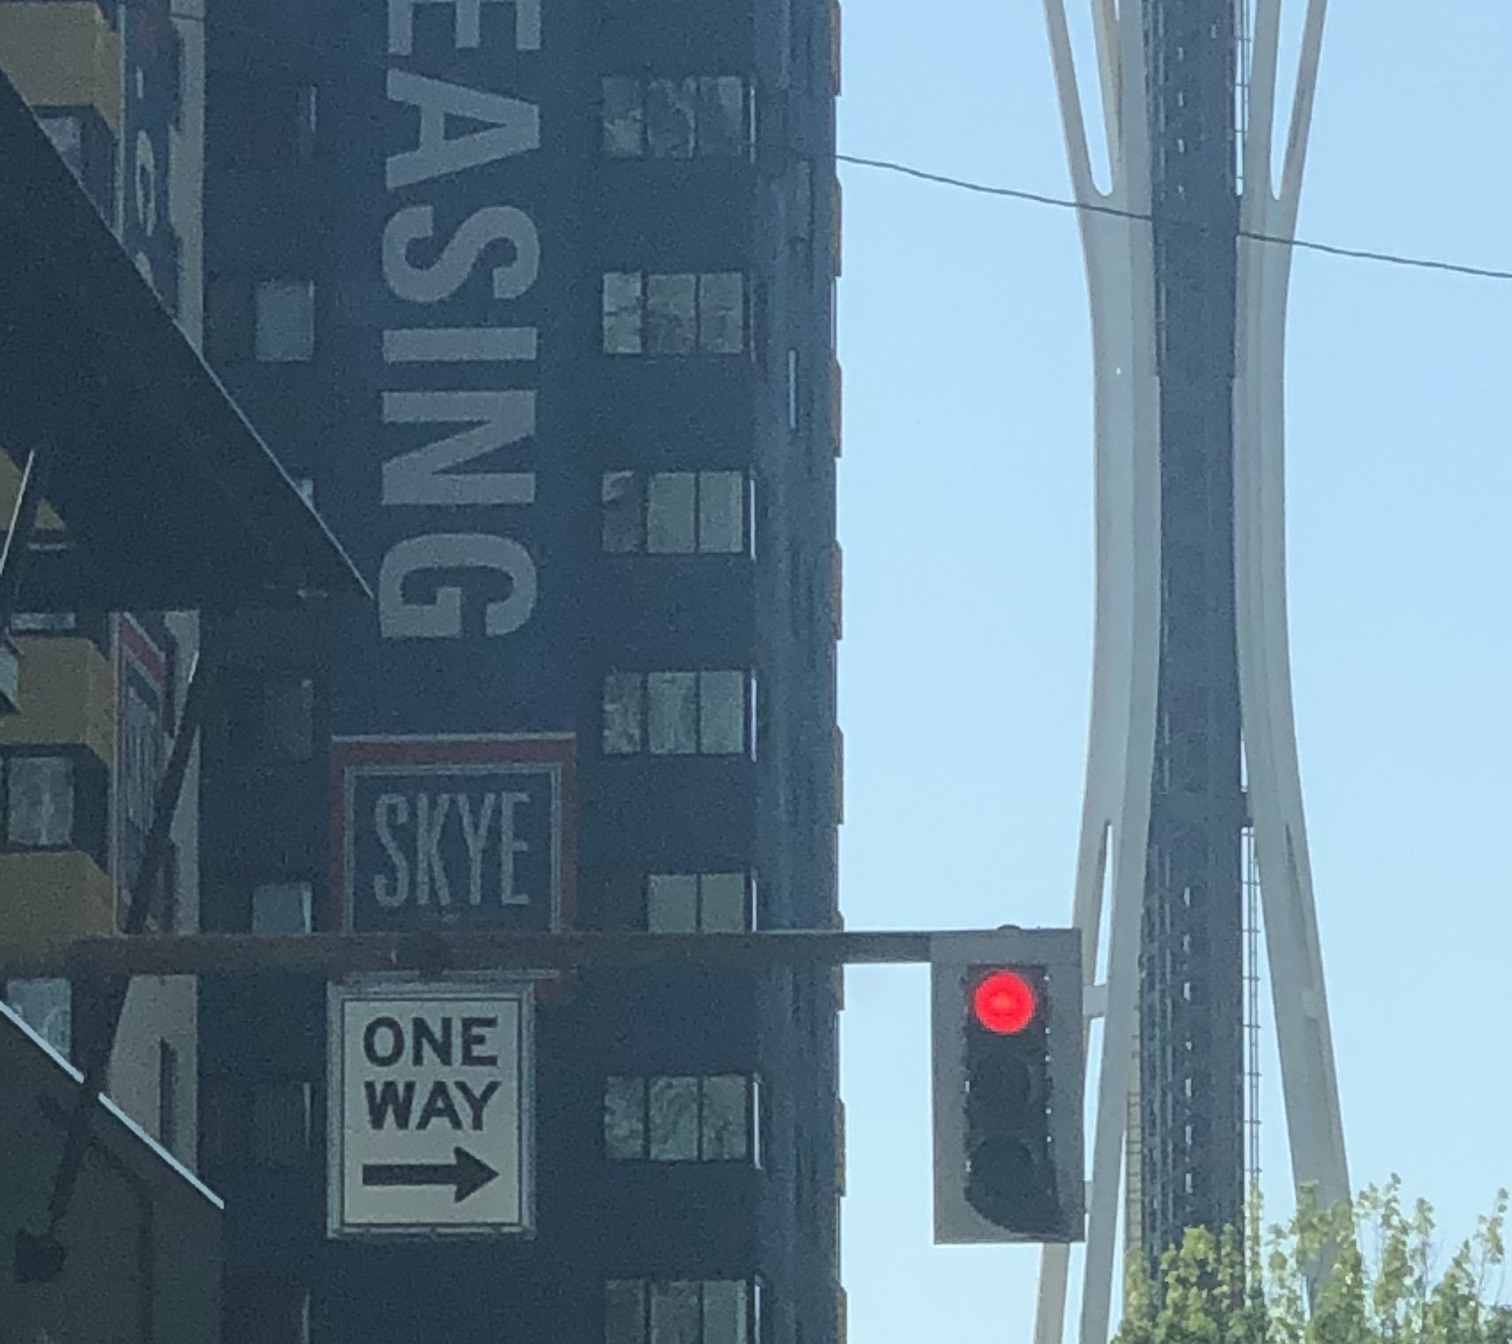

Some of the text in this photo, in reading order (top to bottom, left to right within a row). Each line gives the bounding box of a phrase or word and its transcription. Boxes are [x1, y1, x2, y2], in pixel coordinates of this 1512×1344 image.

[373, 792, 531, 907] SKYE
[363, 1014, 499, 1068] ONE
[363, 1081, 501, 1132] WAY
